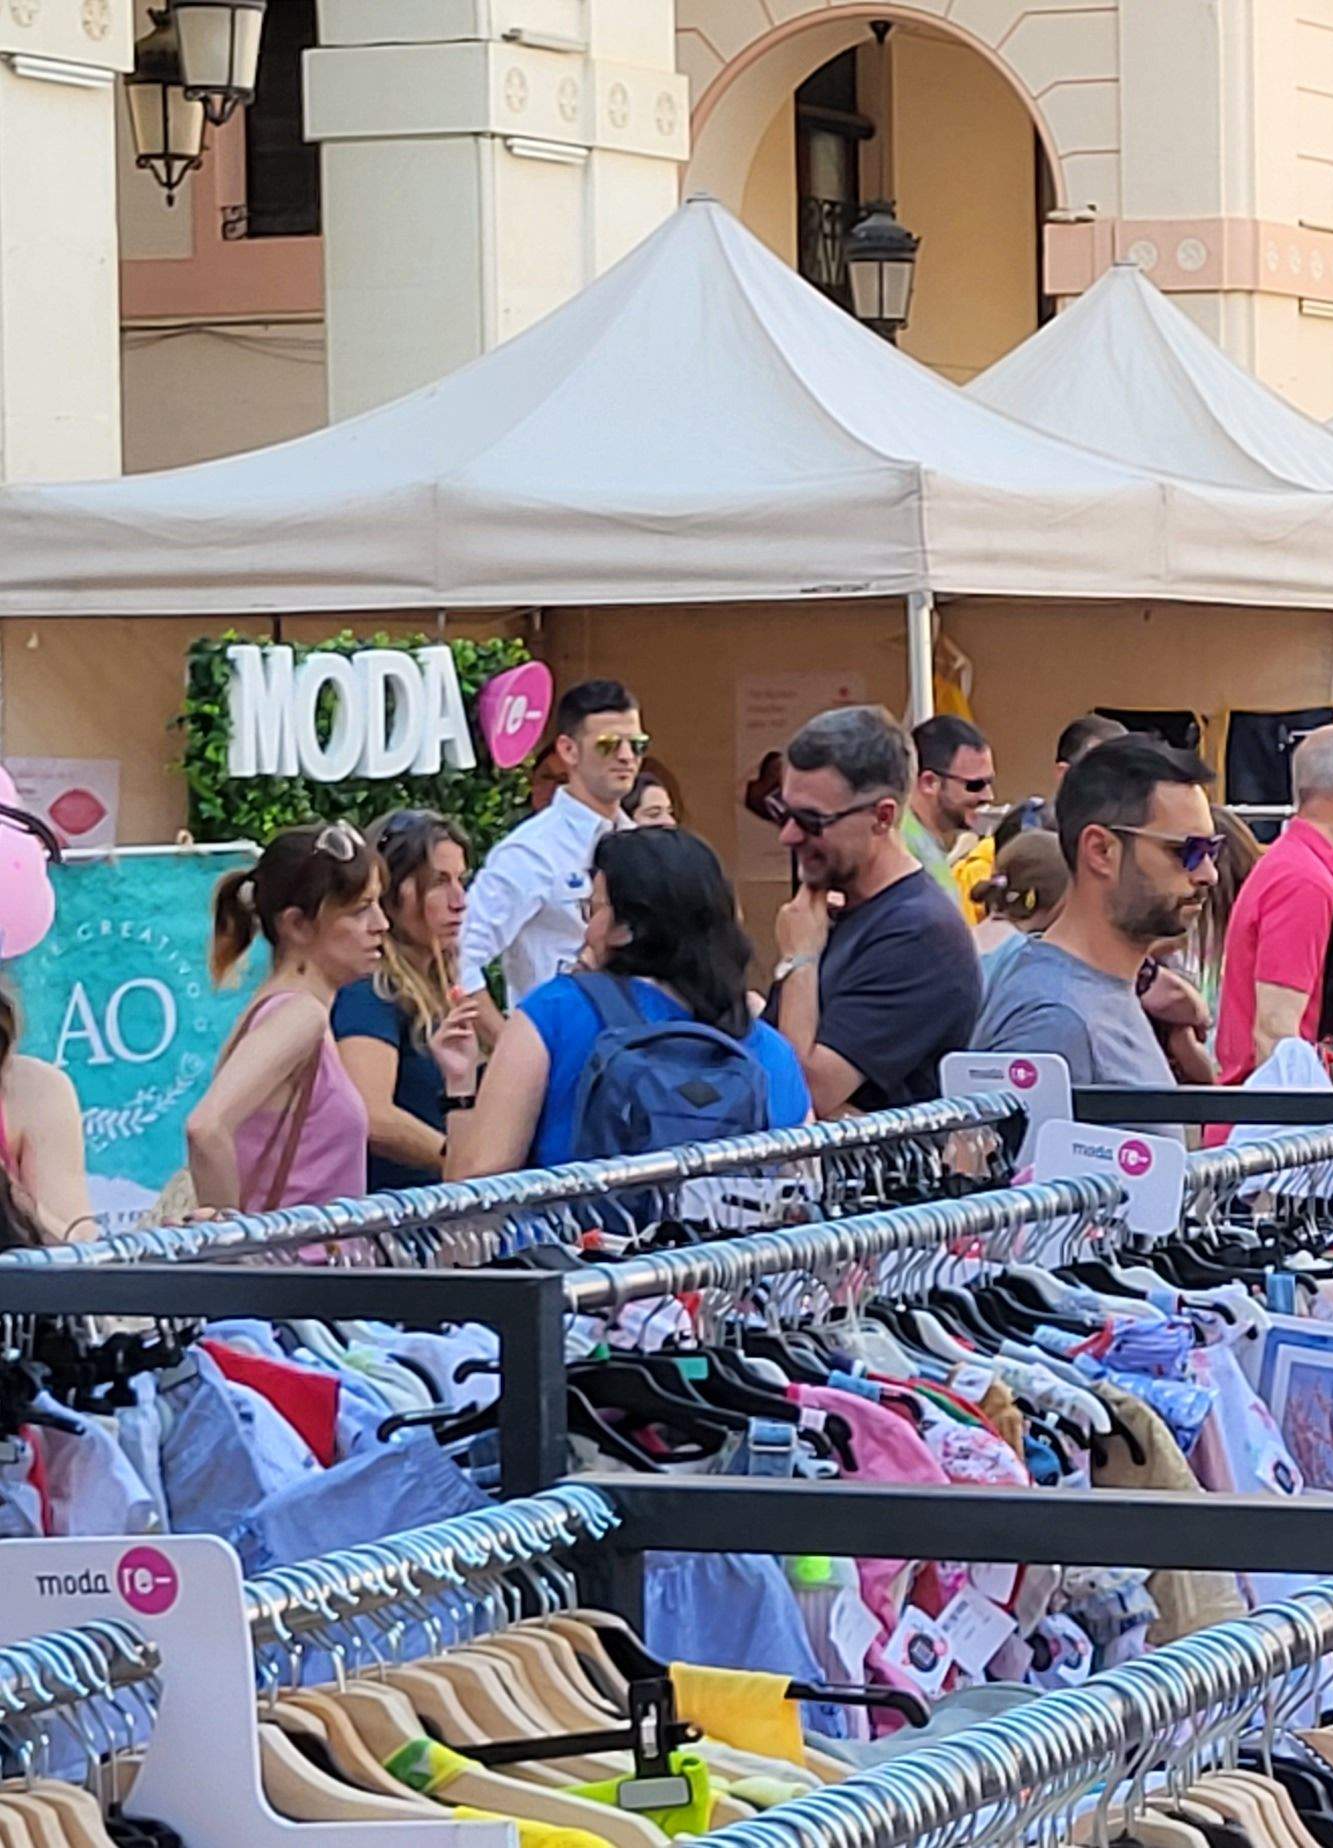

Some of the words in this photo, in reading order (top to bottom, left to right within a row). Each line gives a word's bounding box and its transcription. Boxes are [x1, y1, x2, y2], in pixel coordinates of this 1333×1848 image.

[227, 645, 476, 782] MODA
[76, 919, 201, 998] CREATIVO
[55, 977, 178, 1068] AO
[36, 1568, 111, 1596] moda
